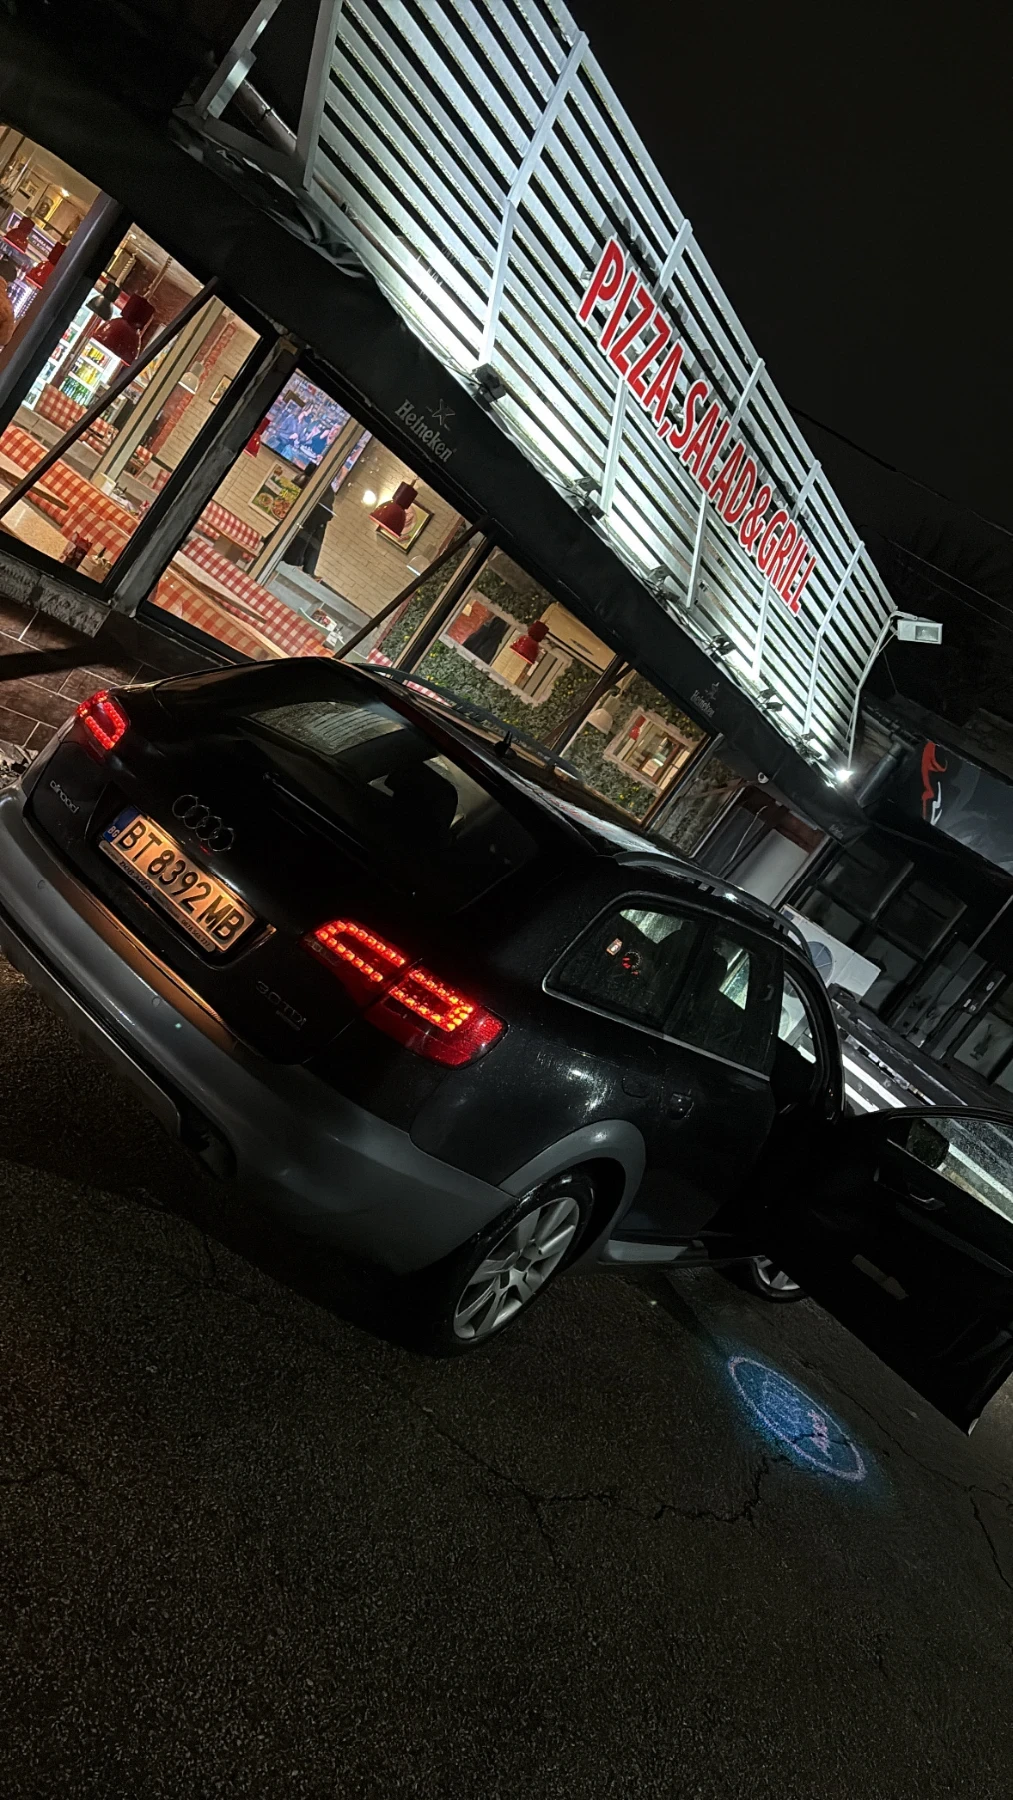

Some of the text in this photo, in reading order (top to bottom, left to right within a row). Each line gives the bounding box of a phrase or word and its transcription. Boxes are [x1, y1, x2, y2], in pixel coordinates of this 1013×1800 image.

[395, 399, 453, 462] Heineken
[107, 825, 120, 838] BG
[116, 820, 163, 862] BT
[147, 849, 212, 915] 8392
[197, 894, 245, 942] MB
